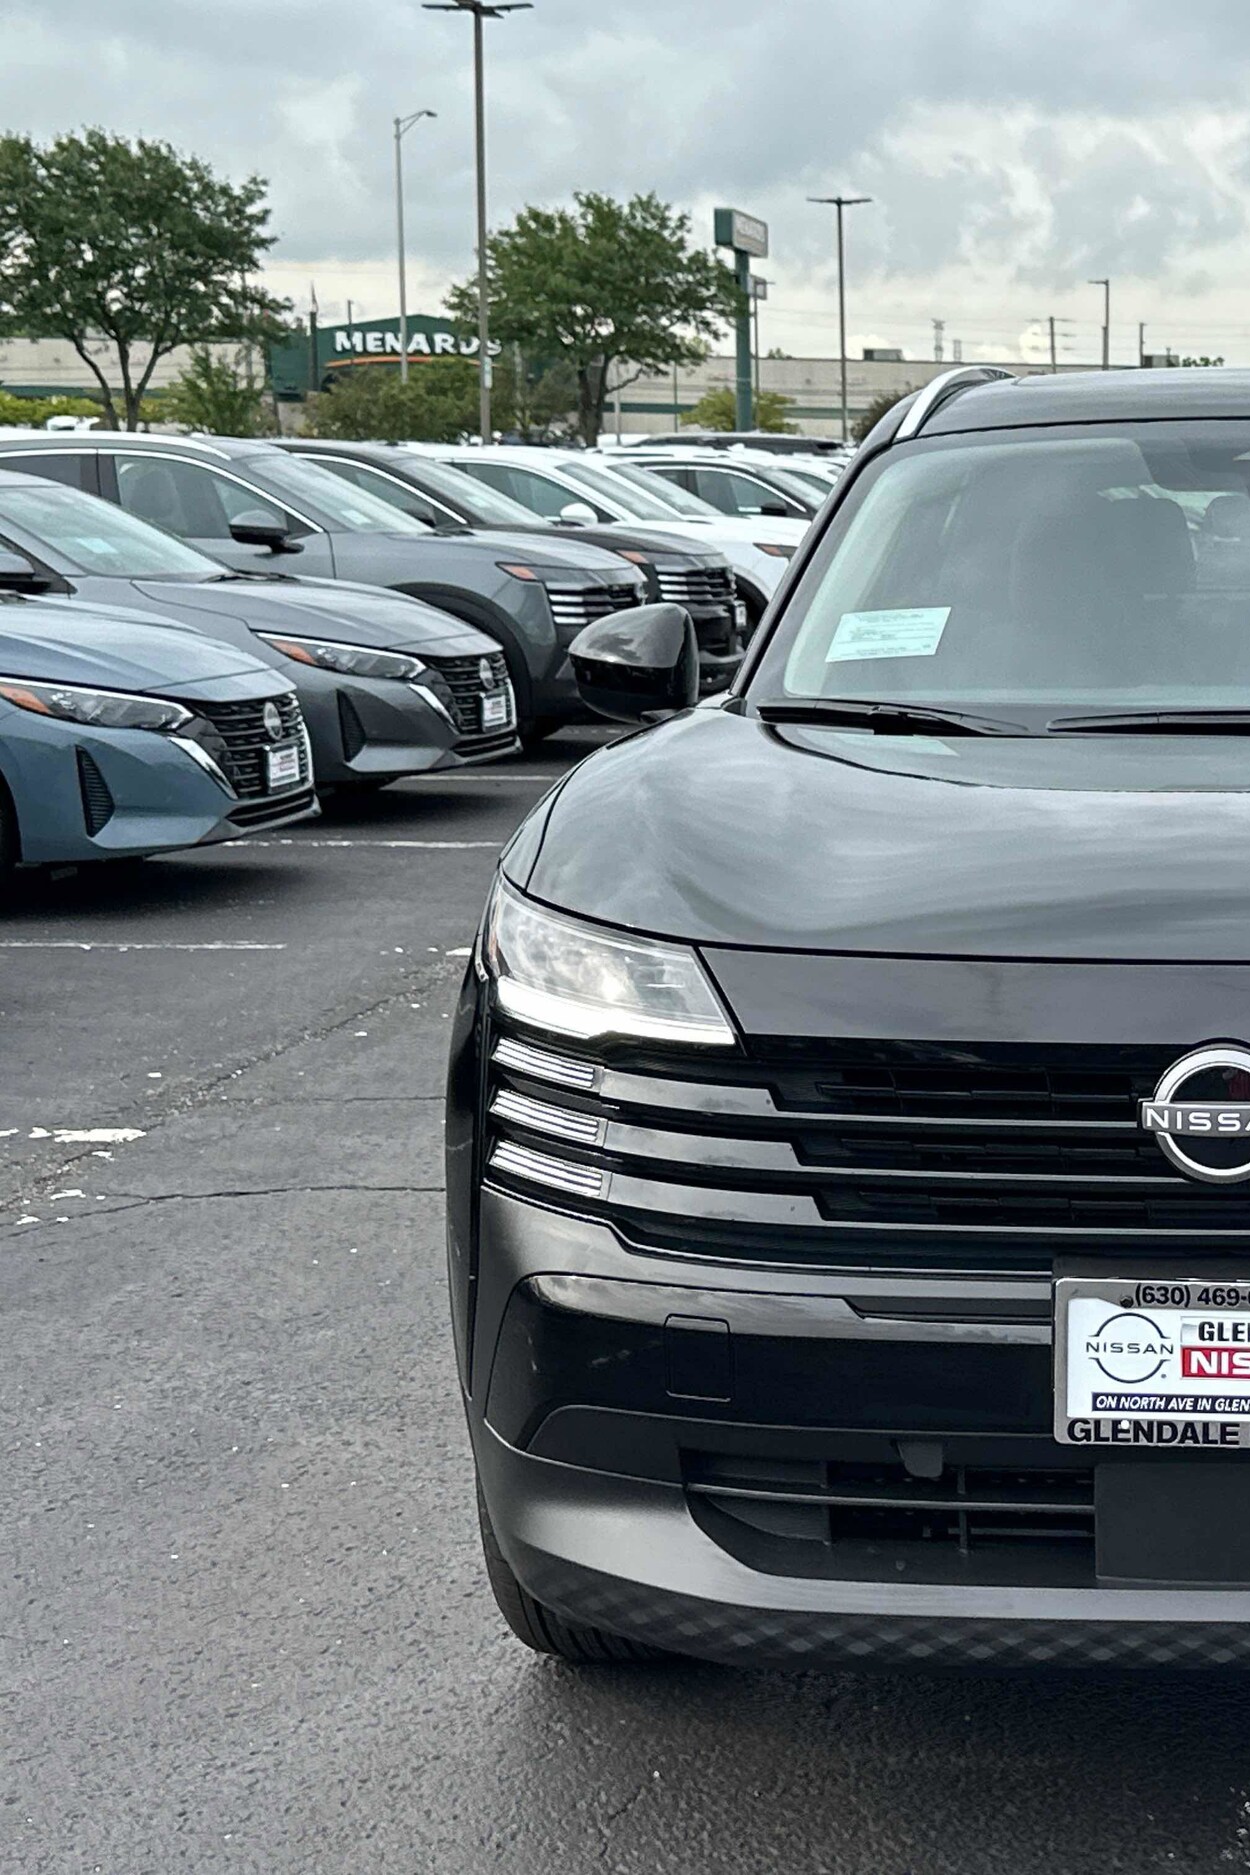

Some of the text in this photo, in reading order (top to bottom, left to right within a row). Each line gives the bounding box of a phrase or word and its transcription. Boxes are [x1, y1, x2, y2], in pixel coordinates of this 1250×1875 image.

[1135, 1283, 1191, 1308] (630)
[1086, 1341, 1174, 1355] NISSAN
[1096, 1395, 1117, 1409] ON
[1119, 1396, 1165, 1410] NORTH
[1167, 1397, 1195, 1411] AVE
[1197, 1398, 1212, 1411] IN
[1067, 1418, 1241, 1445] GLENDALE
